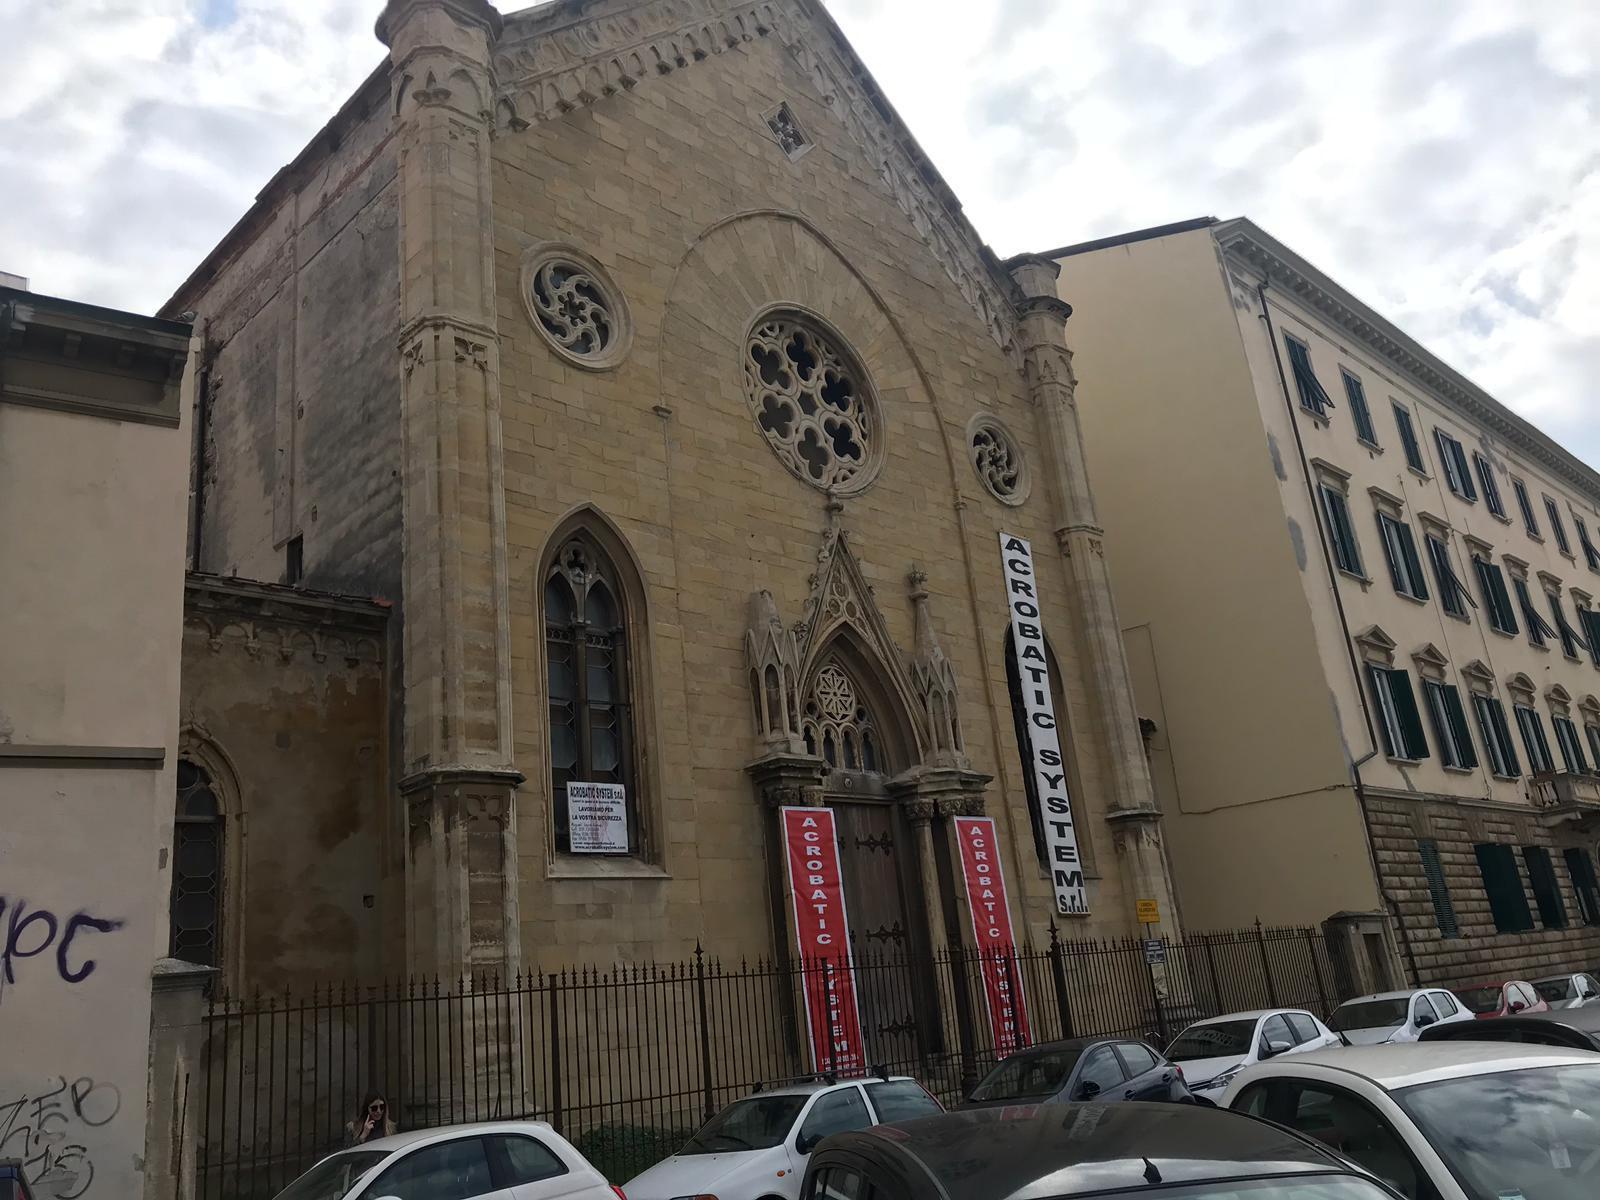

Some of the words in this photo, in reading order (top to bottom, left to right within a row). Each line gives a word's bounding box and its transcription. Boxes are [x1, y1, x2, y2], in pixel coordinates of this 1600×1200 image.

[1004, 538, 1056, 729] ACROBATIC
[571, 787, 595, 799] ACROBATIC
[596, 787, 613, 799] SYSTEM
[1039, 748, 1084, 888] SYSTEM
[802, 817, 832, 945] ACROBATIC
[970, 826, 1000, 938] ACROBATIC
[1058, 888, 1089, 914] s.r.l.
